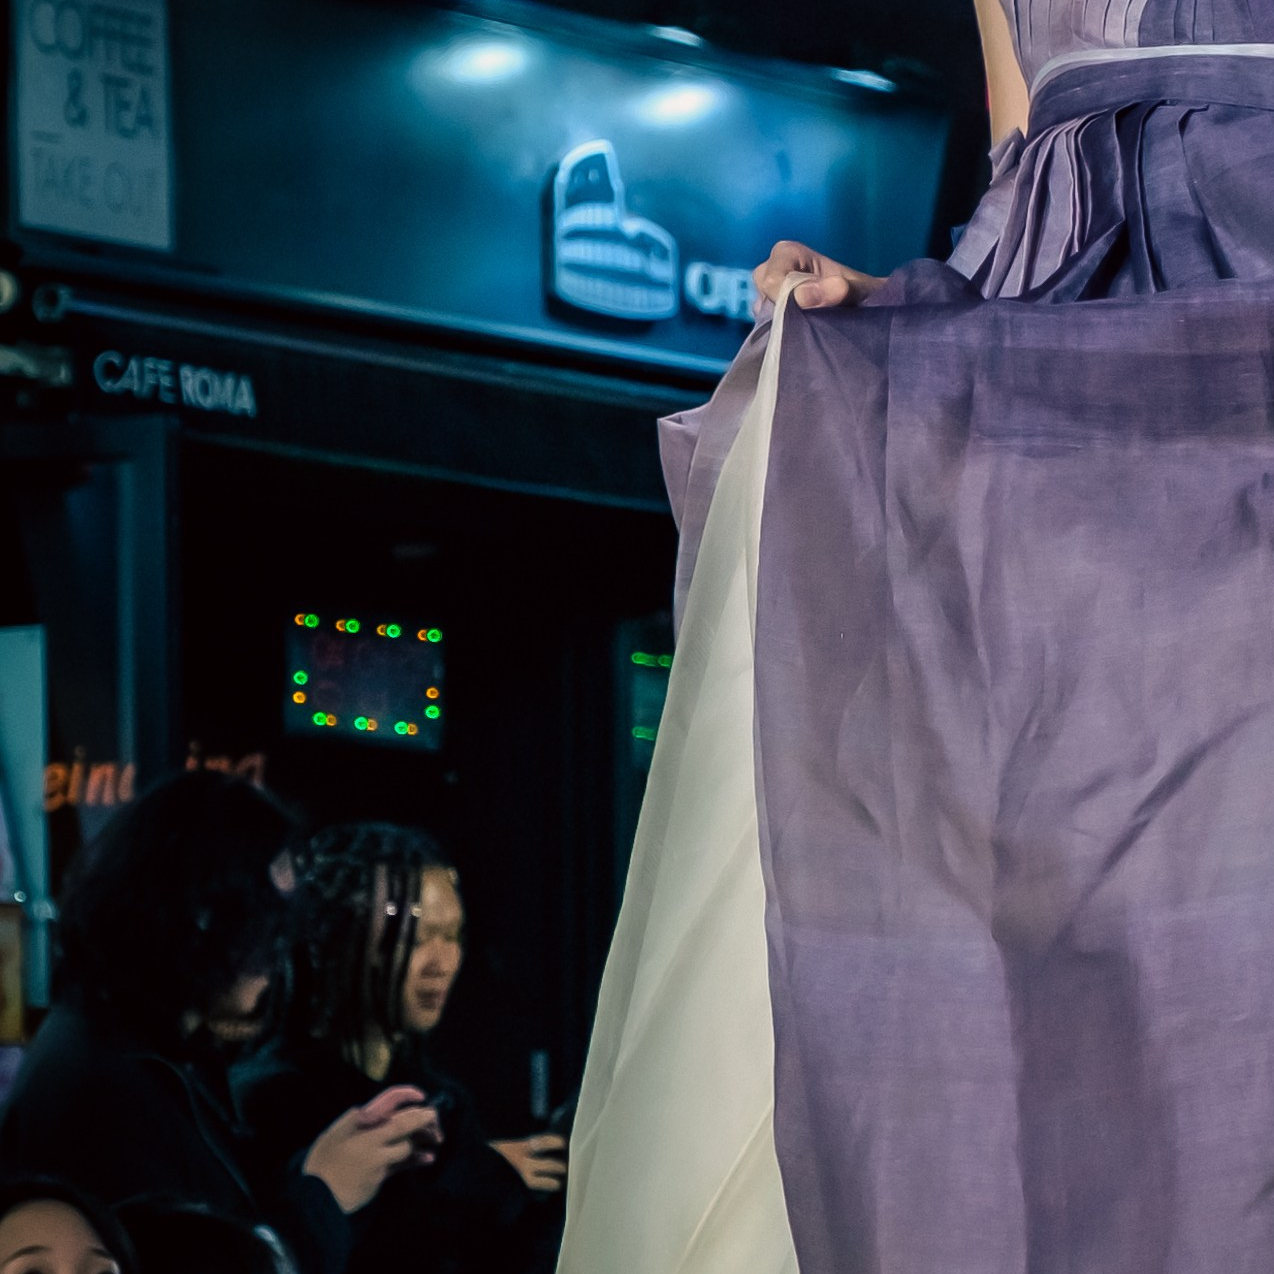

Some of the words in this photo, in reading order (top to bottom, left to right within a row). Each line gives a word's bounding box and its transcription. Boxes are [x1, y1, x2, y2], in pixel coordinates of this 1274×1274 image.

[101, 72, 155, 139] TEA
[93, 349, 177, 404] CAFE
[179, 363, 258, 418] ROMA
